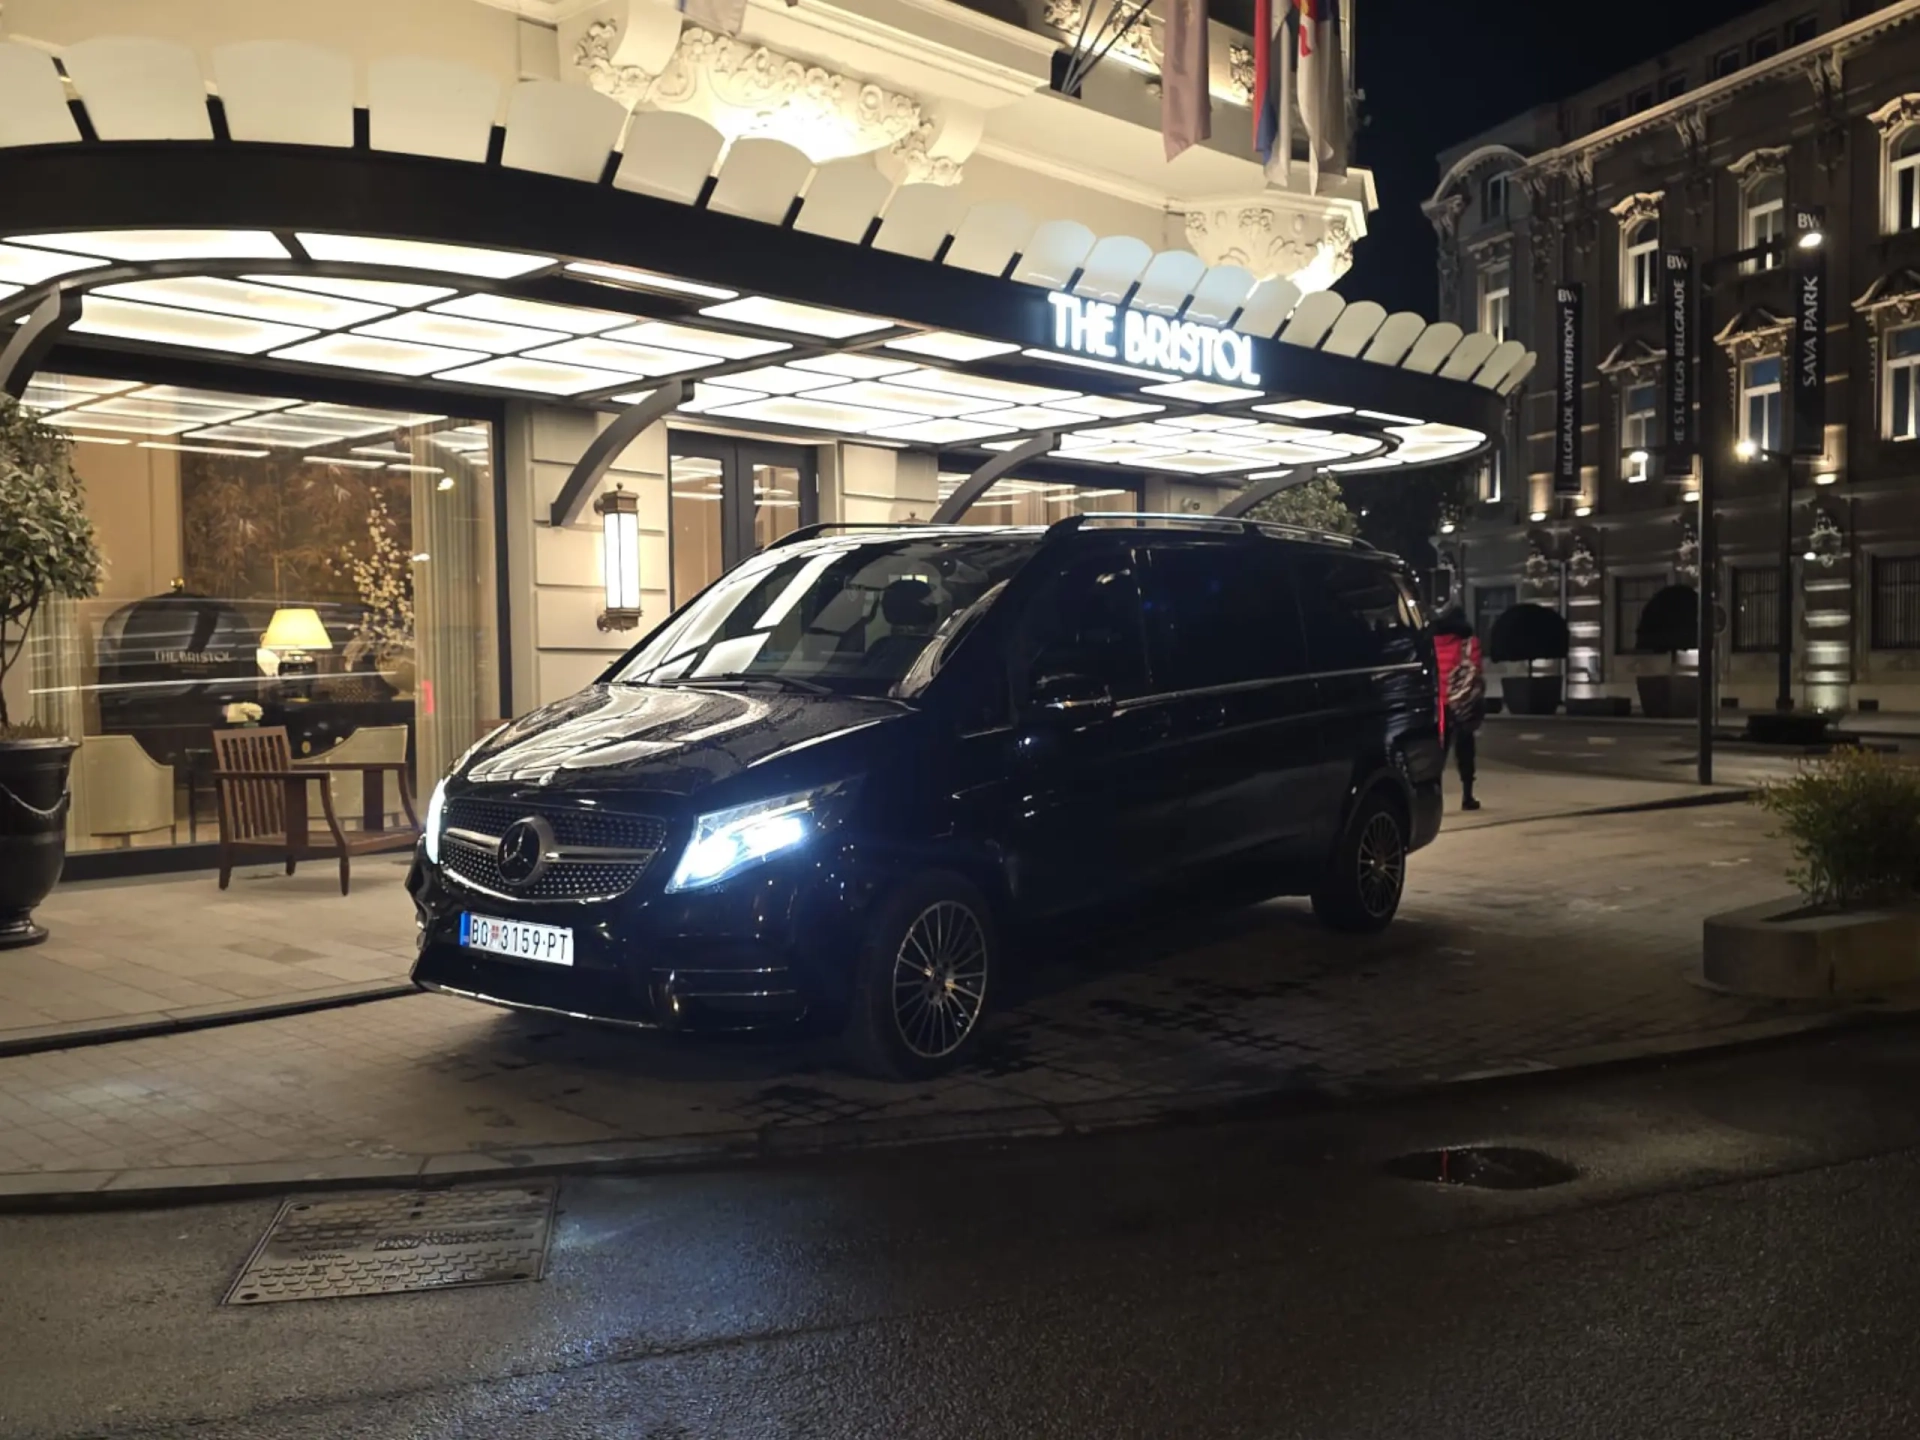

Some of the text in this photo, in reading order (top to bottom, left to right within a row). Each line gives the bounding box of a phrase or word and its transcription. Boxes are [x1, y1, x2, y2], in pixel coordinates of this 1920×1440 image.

[1797, 213, 1822, 229] BW
[1666, 254, 1688, 270] BW
[1047, 290, 1261, 386] THE BRISTOL
[1674, 279, 1685, 357] BELGRADE
[1803, 276, 1818, 387] SAVA PARK
[1563, 307, 1575, 475] BELGRADE WATERFRONT
[1674, 359, 1685, 402] REGIS
[154, 650, 179, 664] THE
